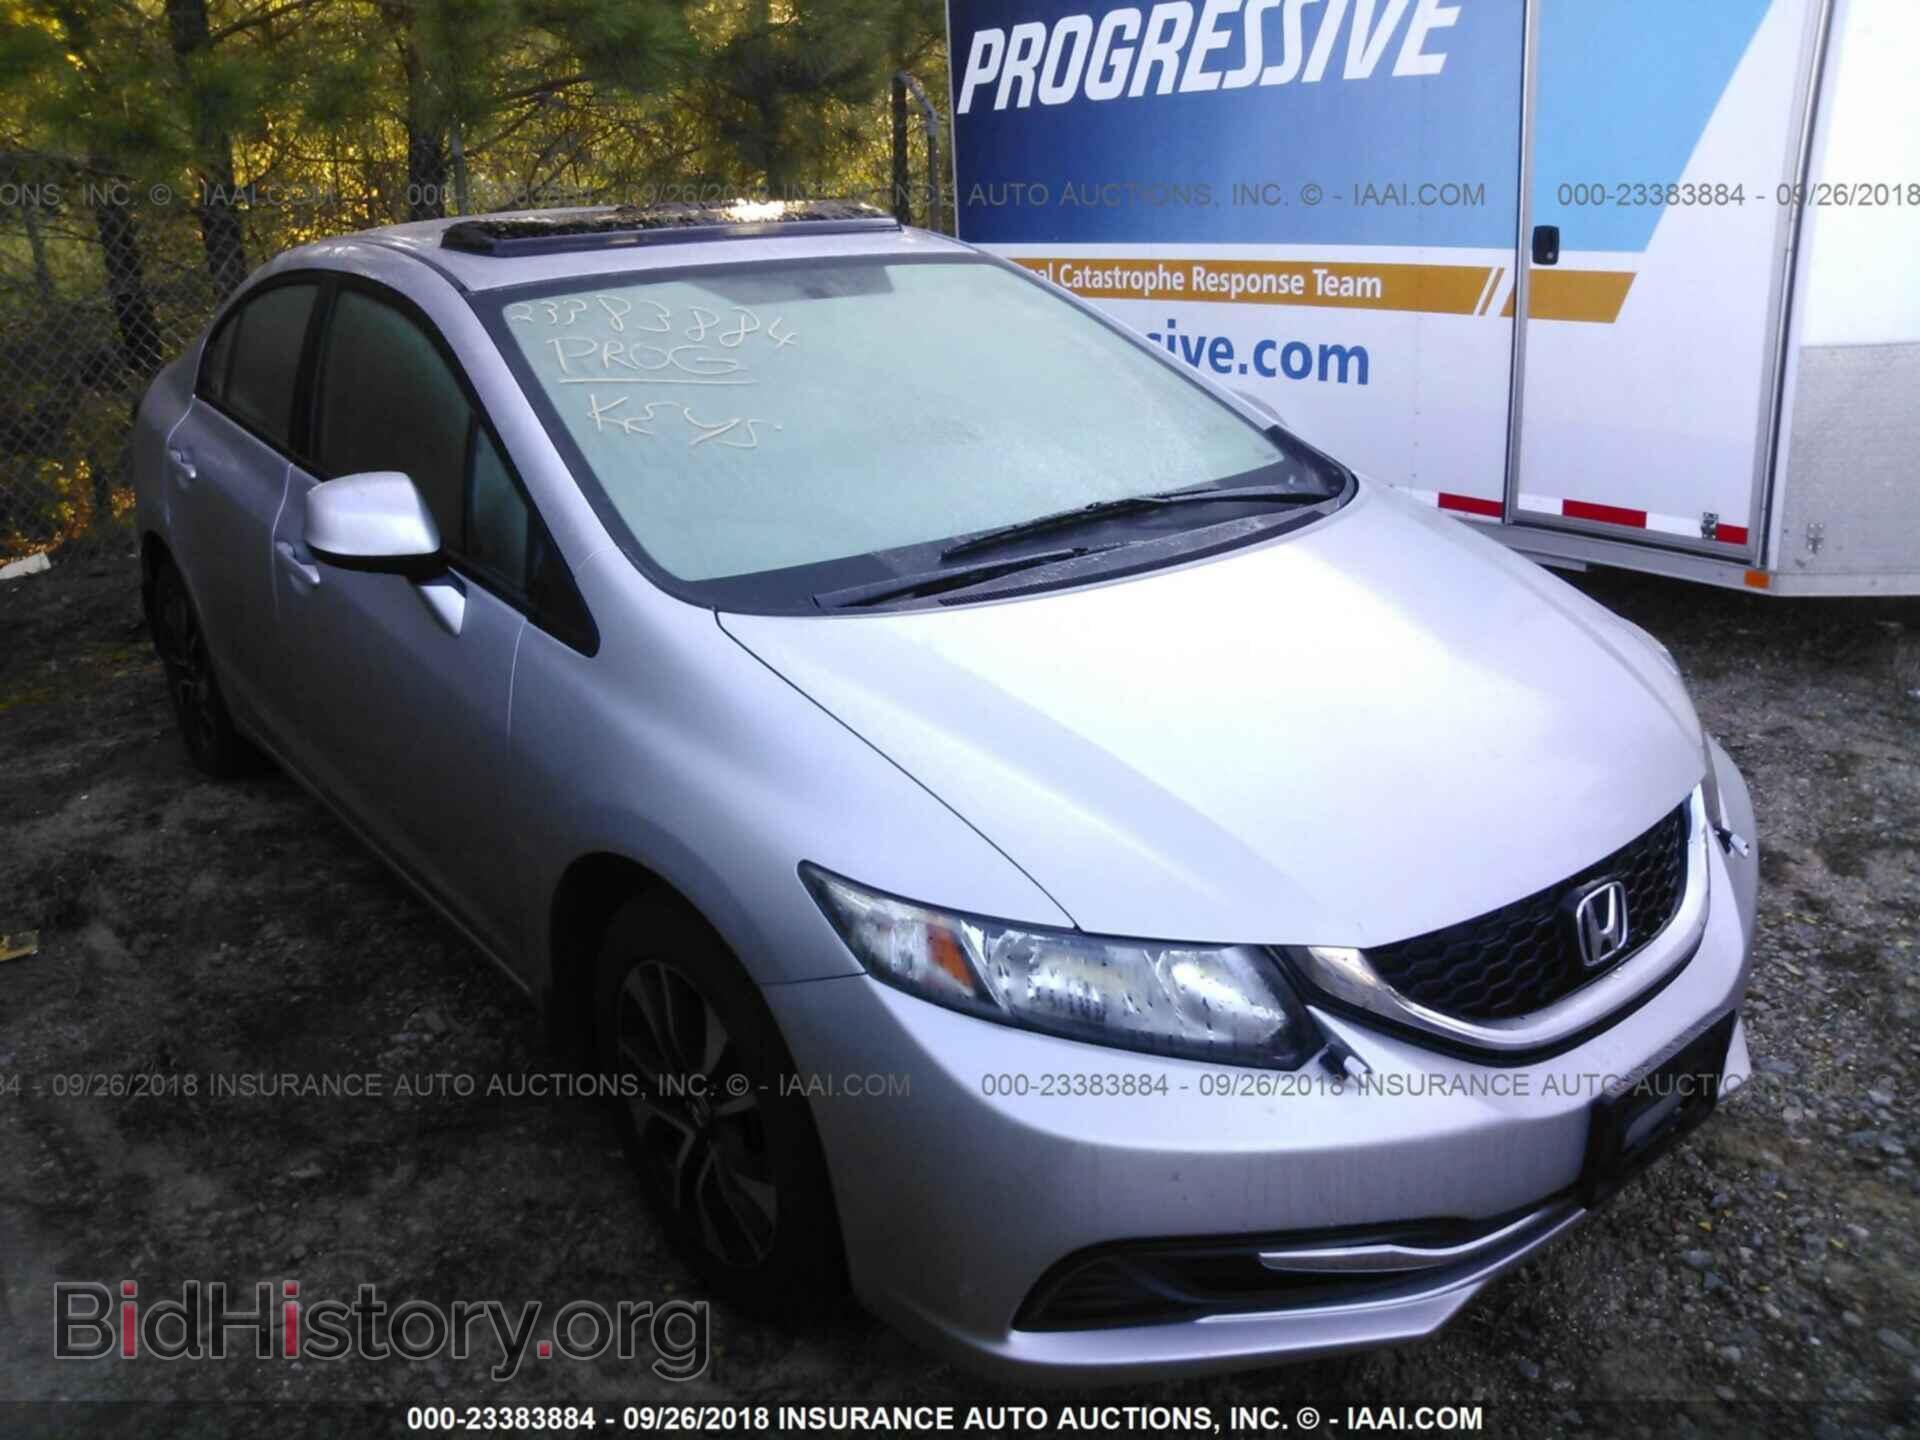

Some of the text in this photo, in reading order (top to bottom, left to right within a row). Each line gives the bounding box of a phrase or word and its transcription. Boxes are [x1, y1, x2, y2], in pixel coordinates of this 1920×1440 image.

[957, 0, 1461, 114] PROGRESSIVE
[1060, 263, 1184, 292] Catastrophe
[1192, 266, 1304, 299] Response
[1312, 268, 1382, 298] Team
[511, 295, 801, 348] 23383884
[546, 337, 748, 374] PROG
